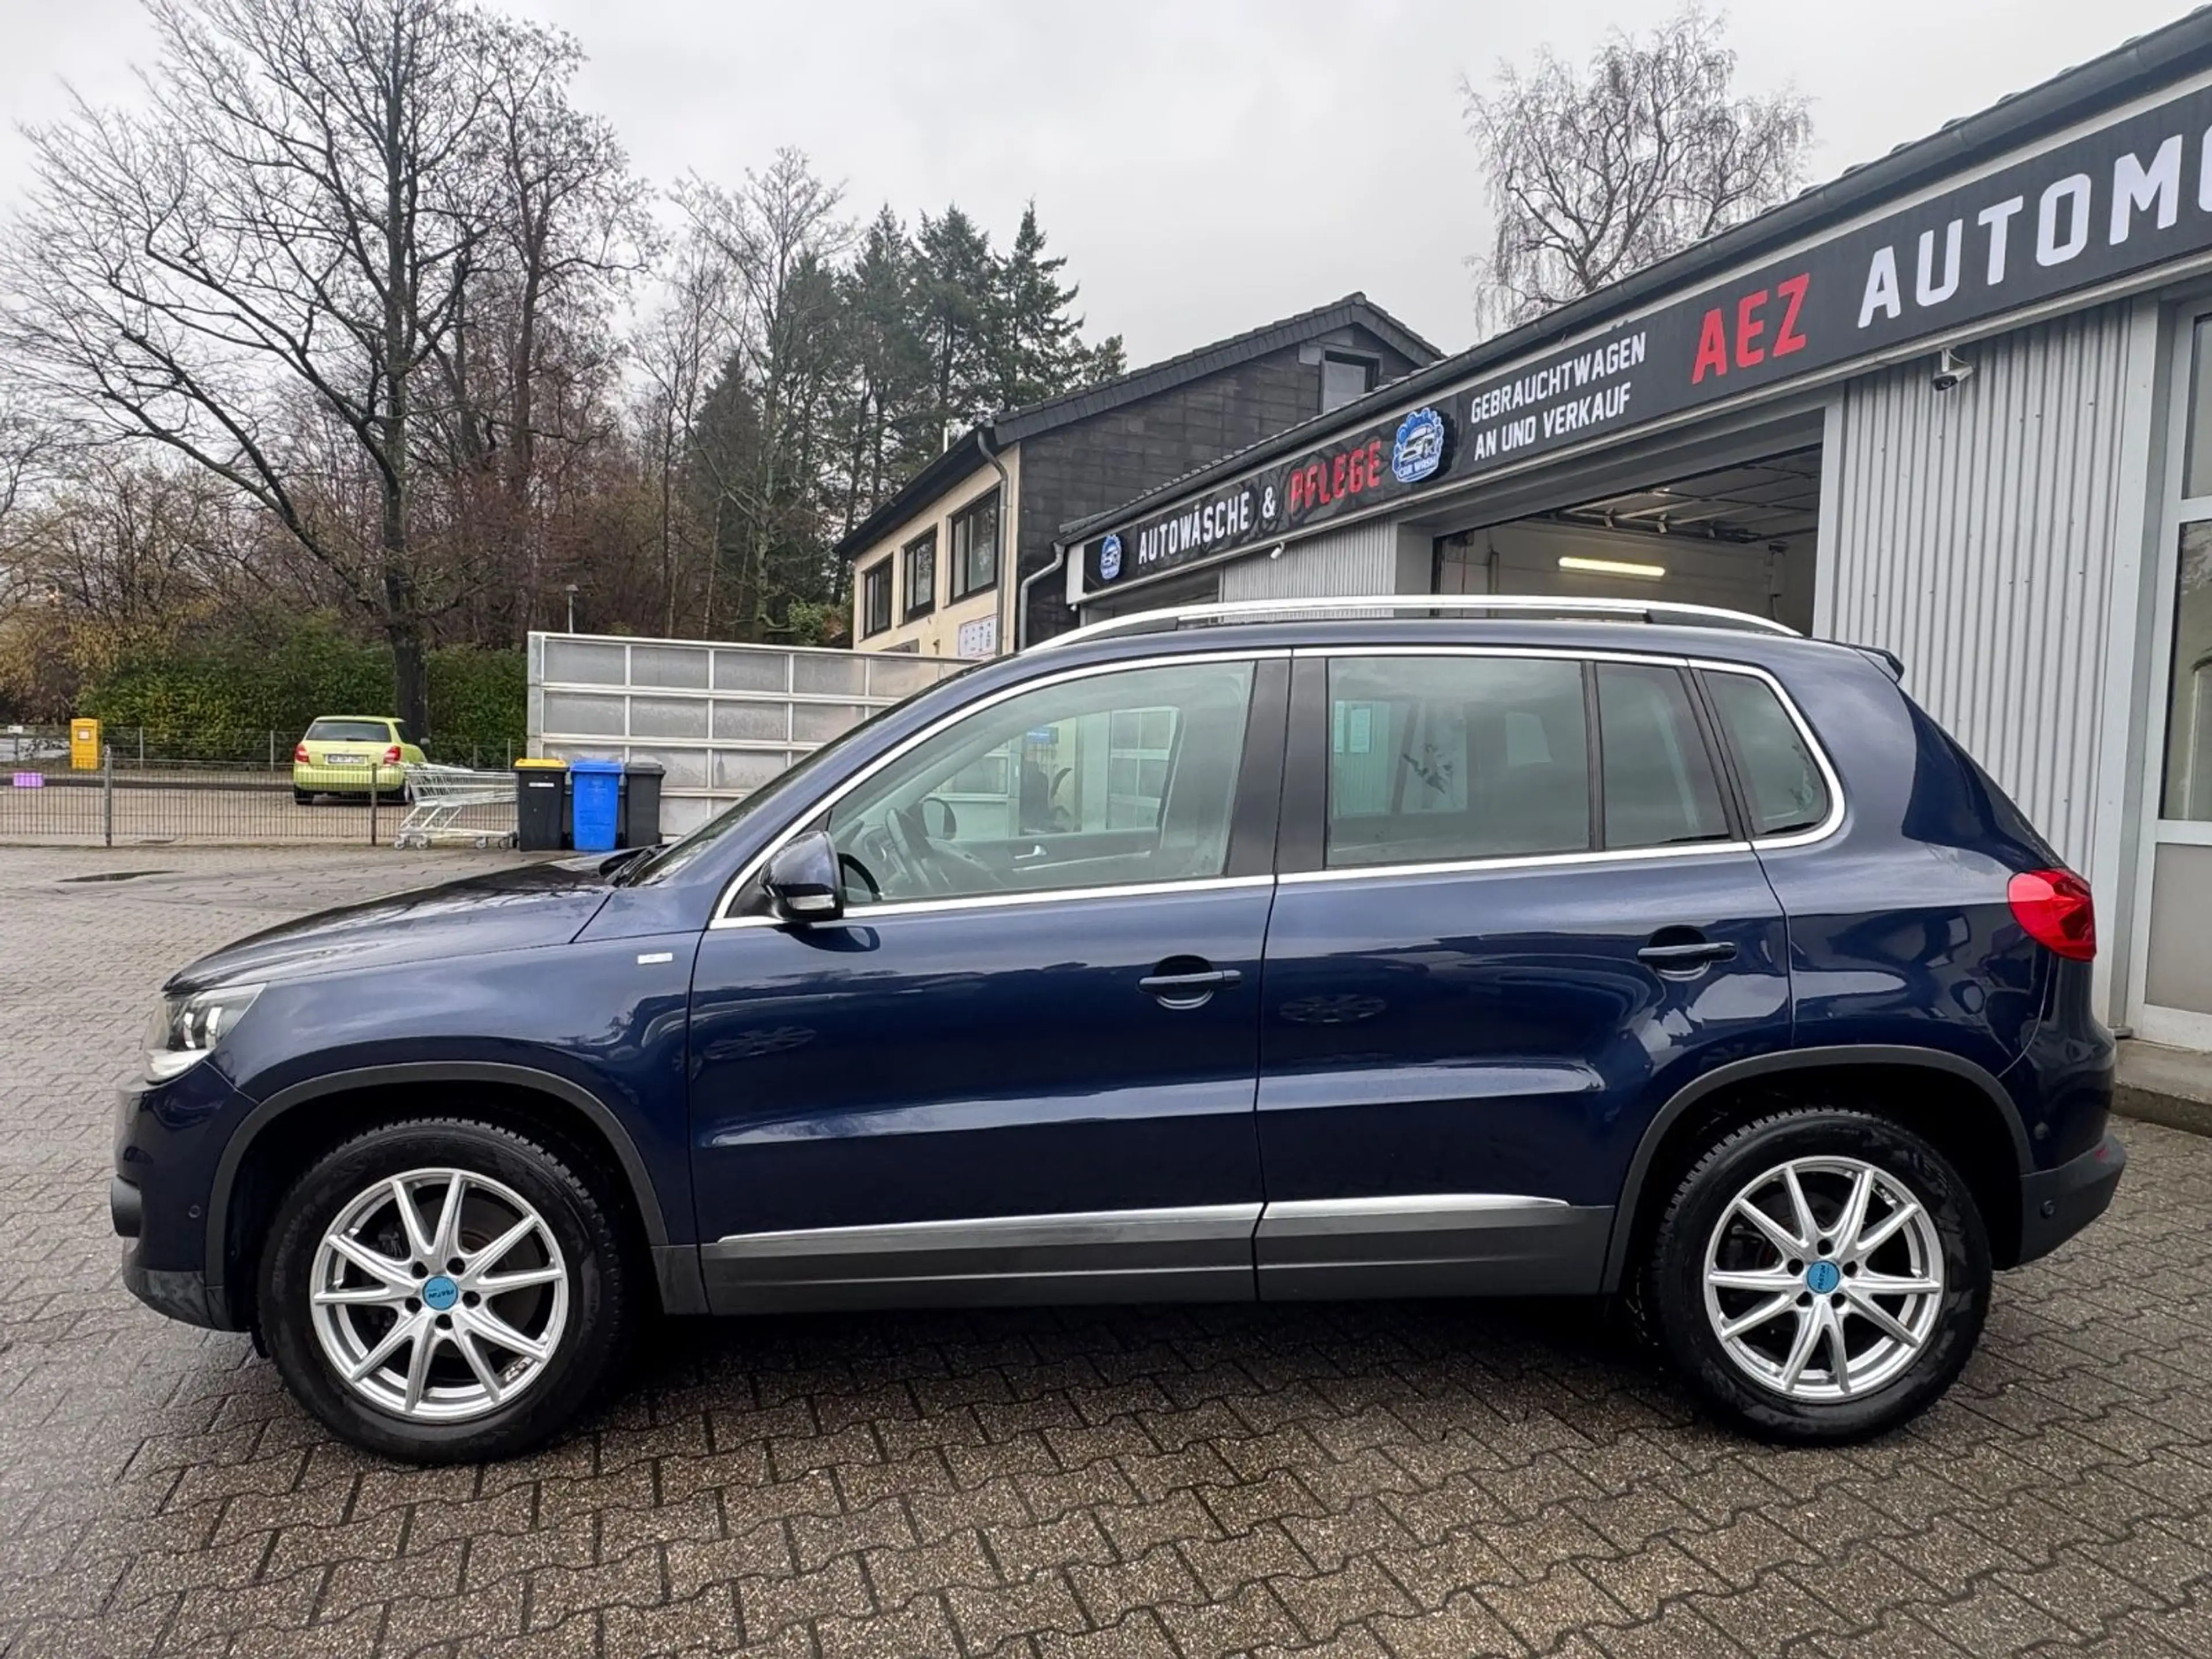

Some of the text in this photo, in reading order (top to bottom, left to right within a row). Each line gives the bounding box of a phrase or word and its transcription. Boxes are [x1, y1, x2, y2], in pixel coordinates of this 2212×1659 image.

[1692, 123, 2212, 385] AEZ AUTOM
[1471, 332, 1646, 423] GEBRAUCHTWAGEN
[1474, 381, 1631, 461] AN UND VERKAUF
[1138, 440, 1381, 565] AUTOWÄSCHE & PFLEGE
